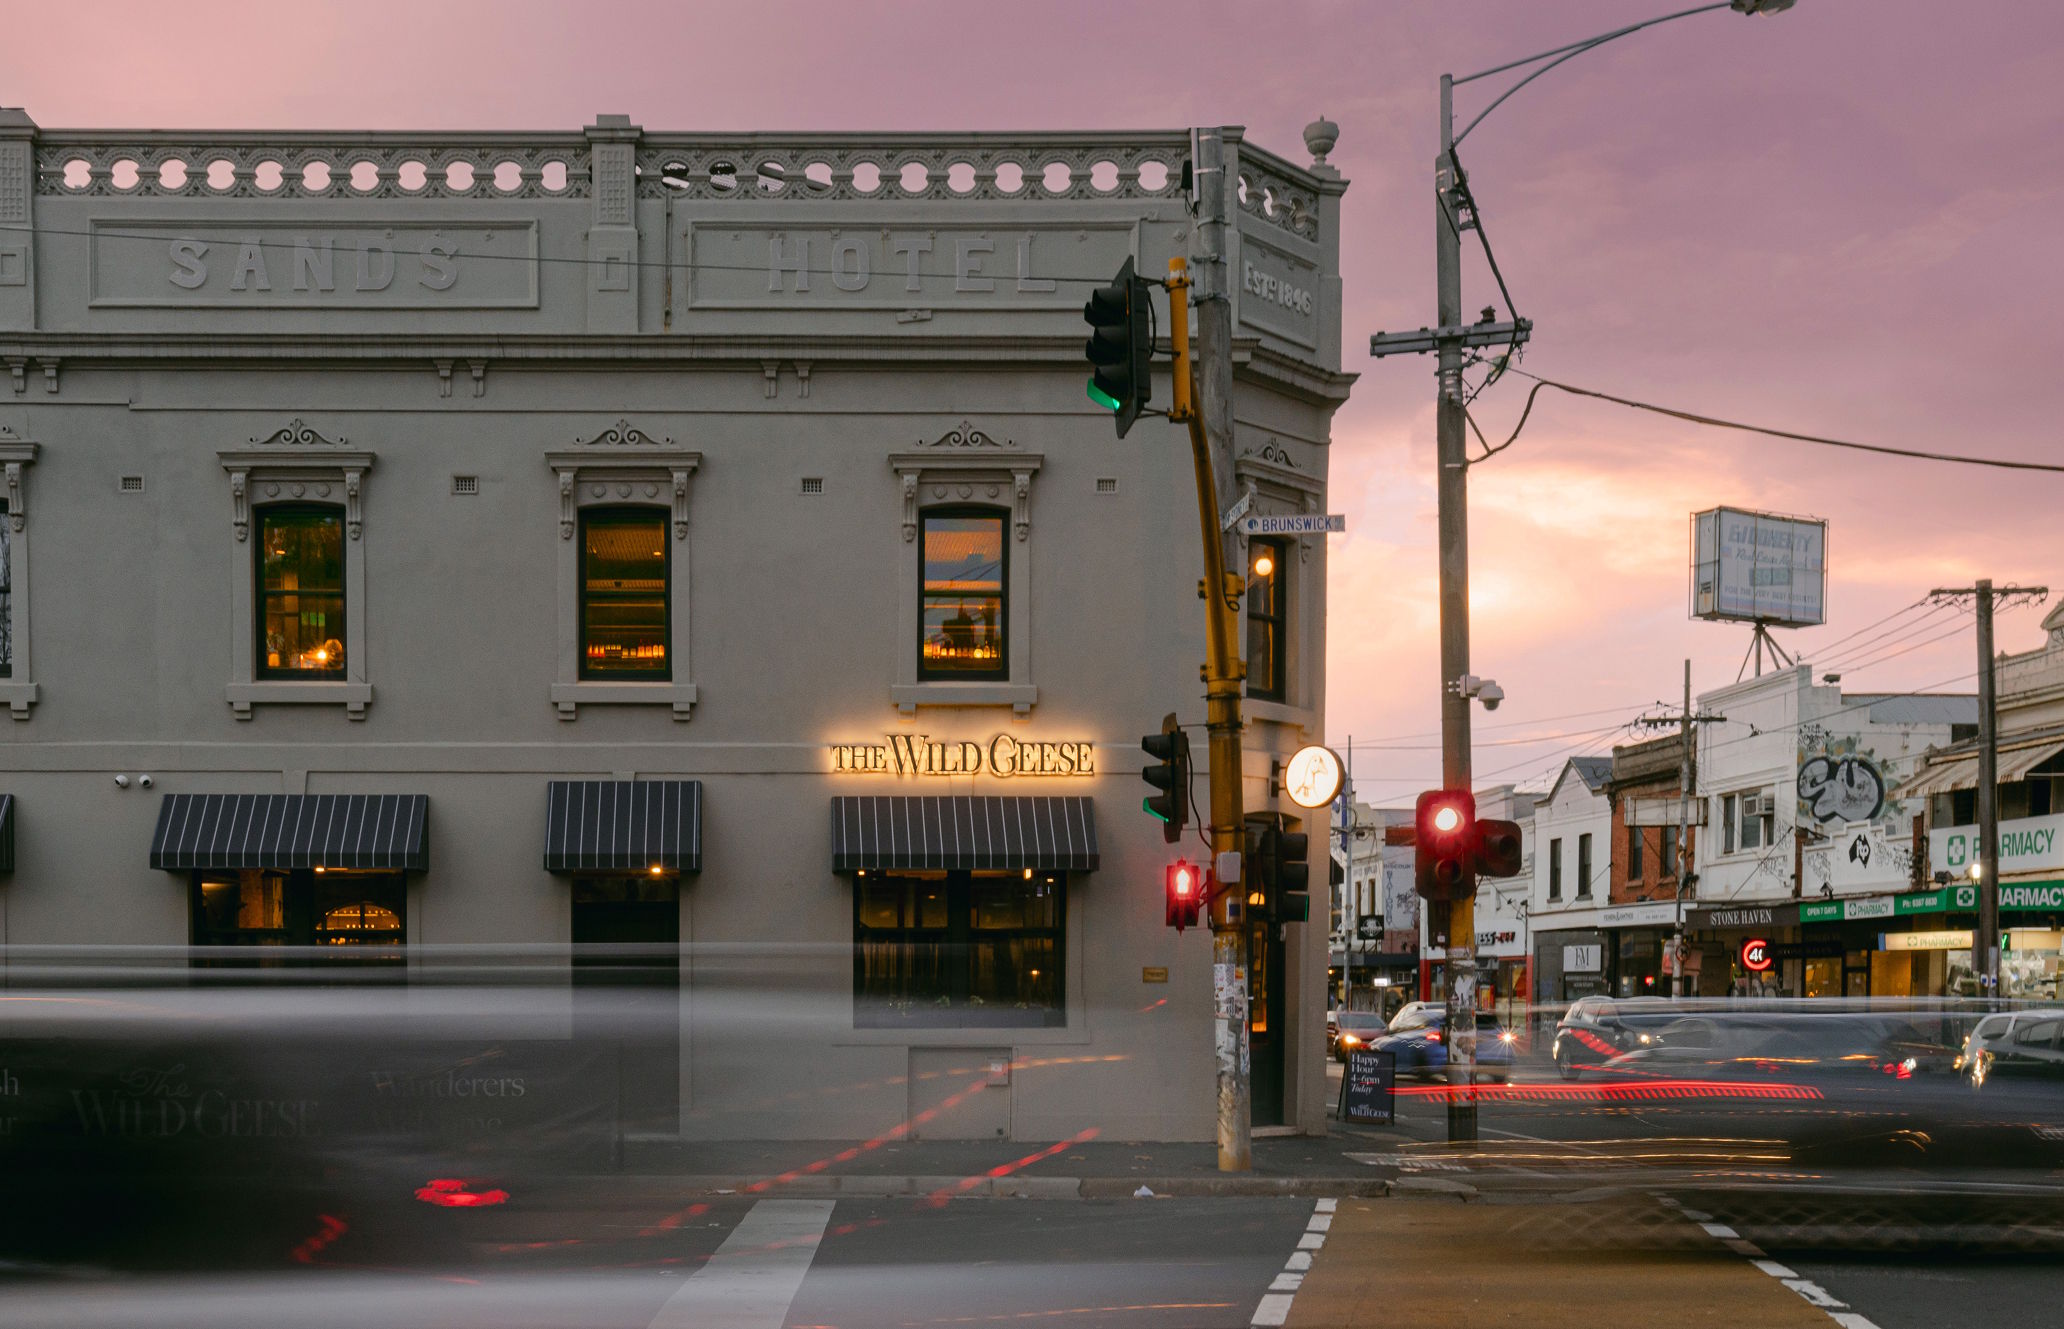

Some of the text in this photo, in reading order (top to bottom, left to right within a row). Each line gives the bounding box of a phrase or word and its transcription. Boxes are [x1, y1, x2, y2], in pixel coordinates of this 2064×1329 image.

[169, 236, 459, 290] SANDS
[768, 238, 1055, 292] HOTEL
[1278, 280, 1312, 314] 1846
[1262, 518, 1331, 531] BRUNSWICK
[833, 734, 1094, 776] THE WILD GEESE
[1807, 907, 1820, 916] OPEN
[1857, 903, 1889, 916] PHARMACY
[1710, 909, 1772, 925] STONE HAVEN
[1920, 937, 1963, 947] PHARMACY
[1351, 1054, 1380, 1066] Happy
[1351, 1063, 1375, 1073] Hour
[1351, 1084, 1373, 1096] Today
